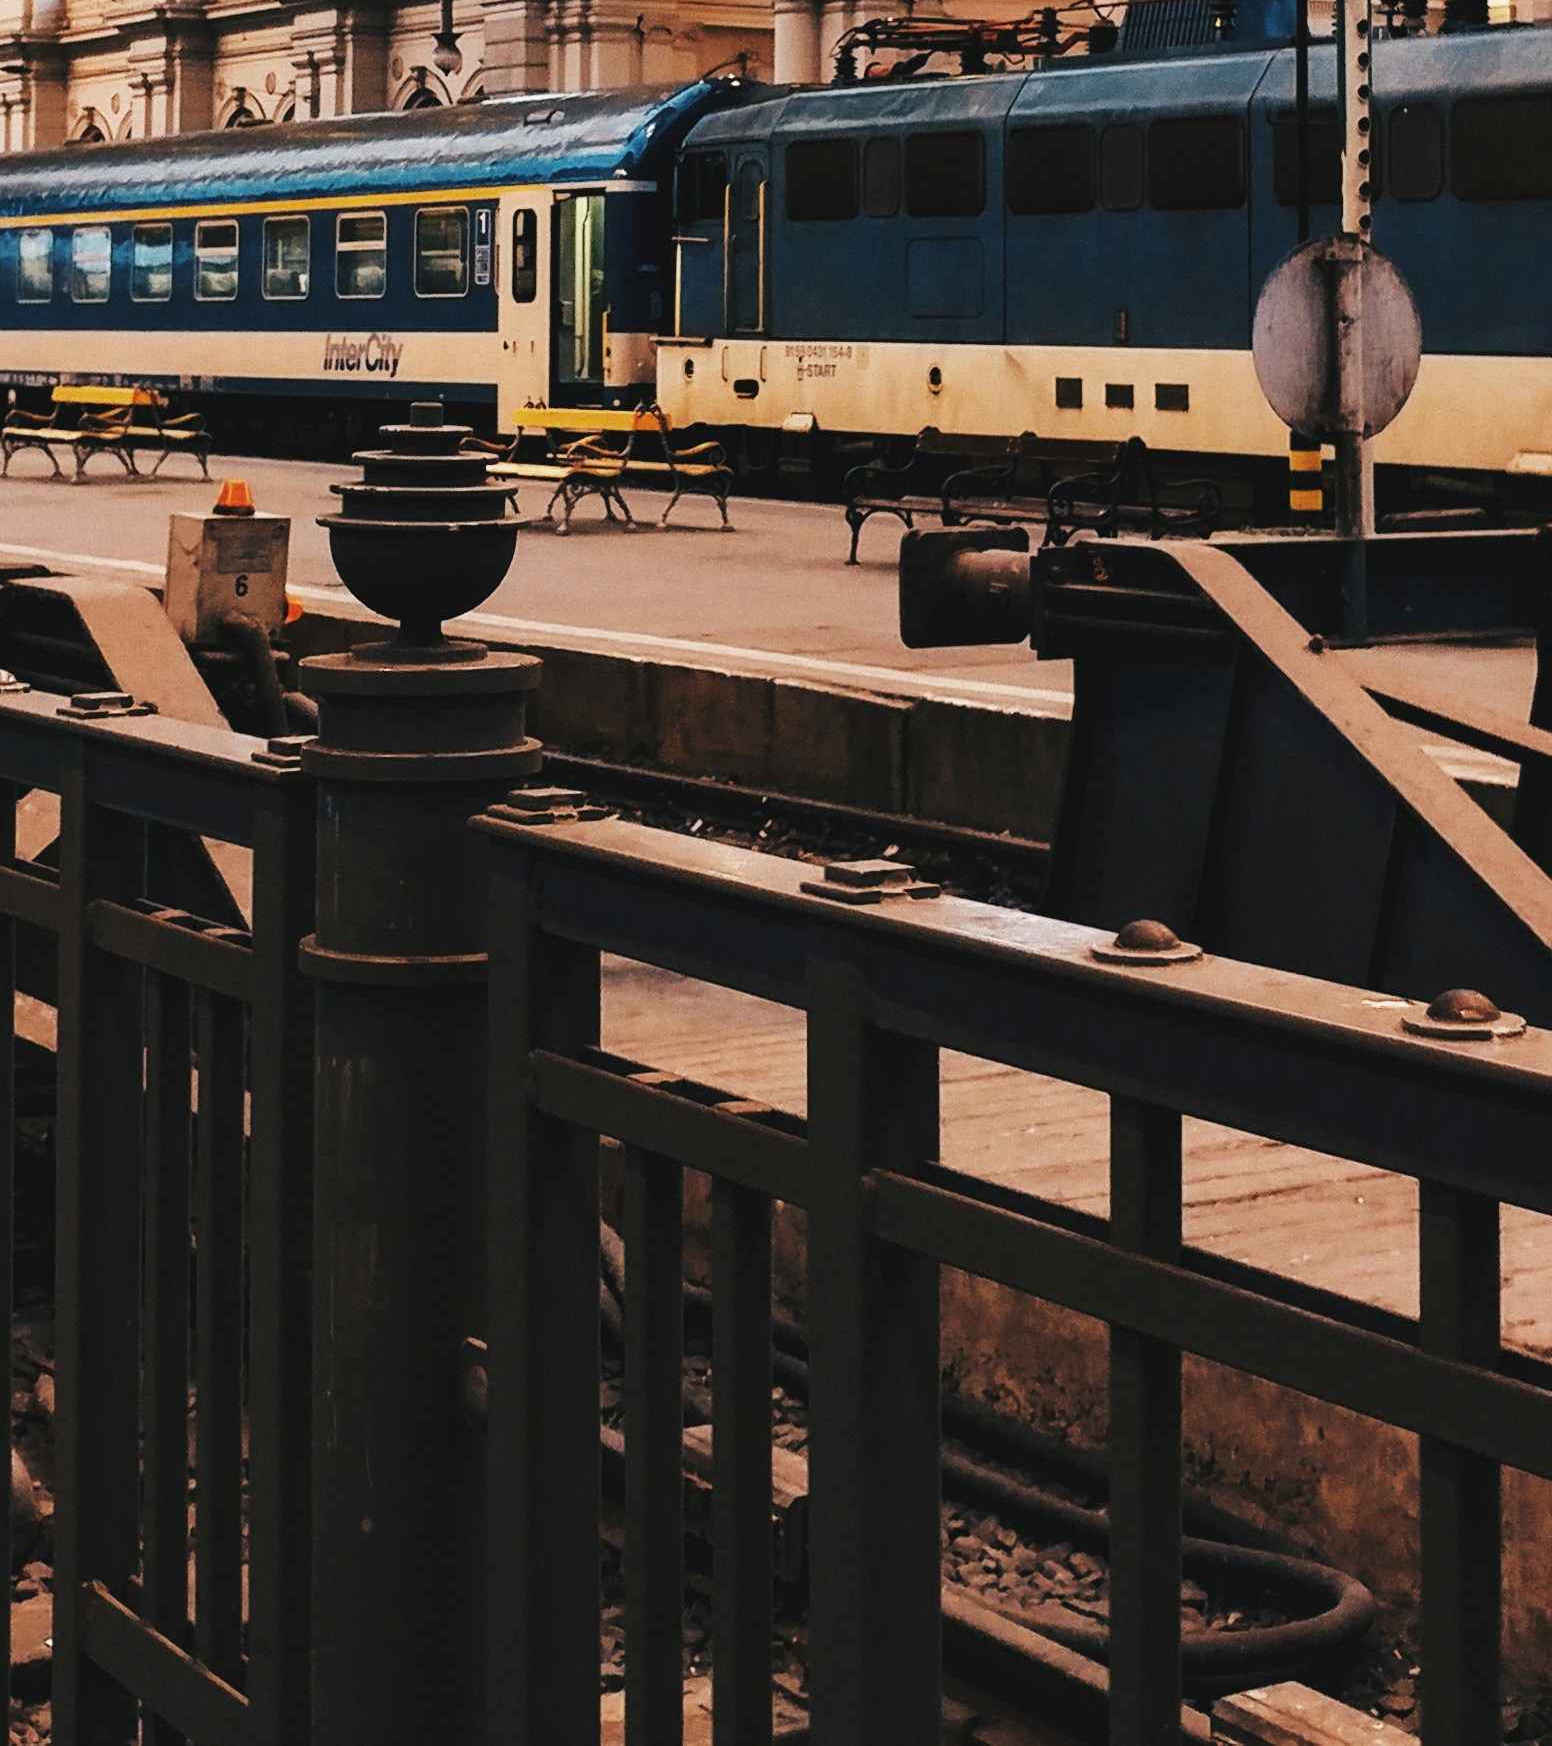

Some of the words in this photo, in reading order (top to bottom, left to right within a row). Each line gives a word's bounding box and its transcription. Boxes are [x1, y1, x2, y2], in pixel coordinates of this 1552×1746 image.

[478, 212, 487, 235] 1
[323, 333, 405, 378] InterCity
[796, 364, 837, 379] H-START
[235, 573, 249, 598] 6
